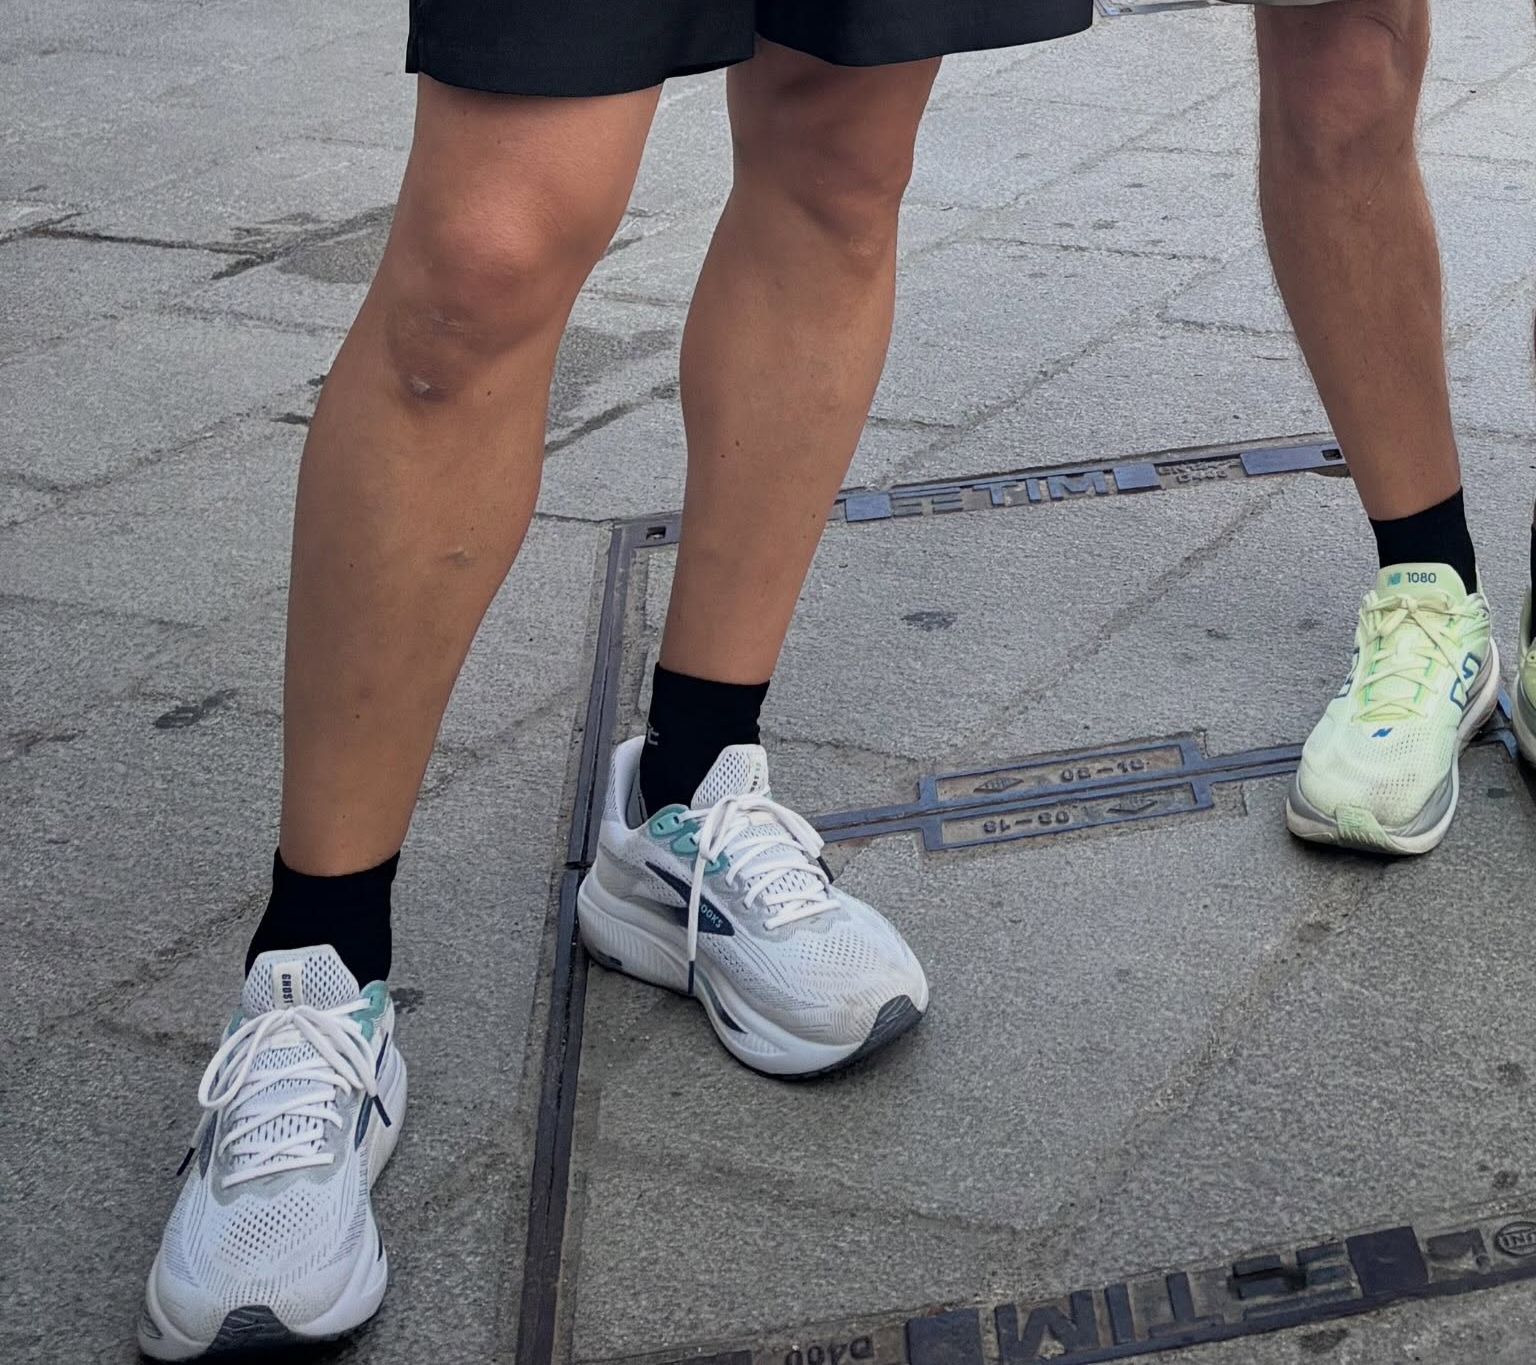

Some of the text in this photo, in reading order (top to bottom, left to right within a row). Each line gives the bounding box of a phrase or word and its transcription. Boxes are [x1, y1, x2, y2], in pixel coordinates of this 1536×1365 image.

[972, 470, 1109, 507] TIM
[1405, 571, 1437, 585] 1080
[700, 904, 724, 930] OOKS
[281, 973, 294, 1004] GHOST
